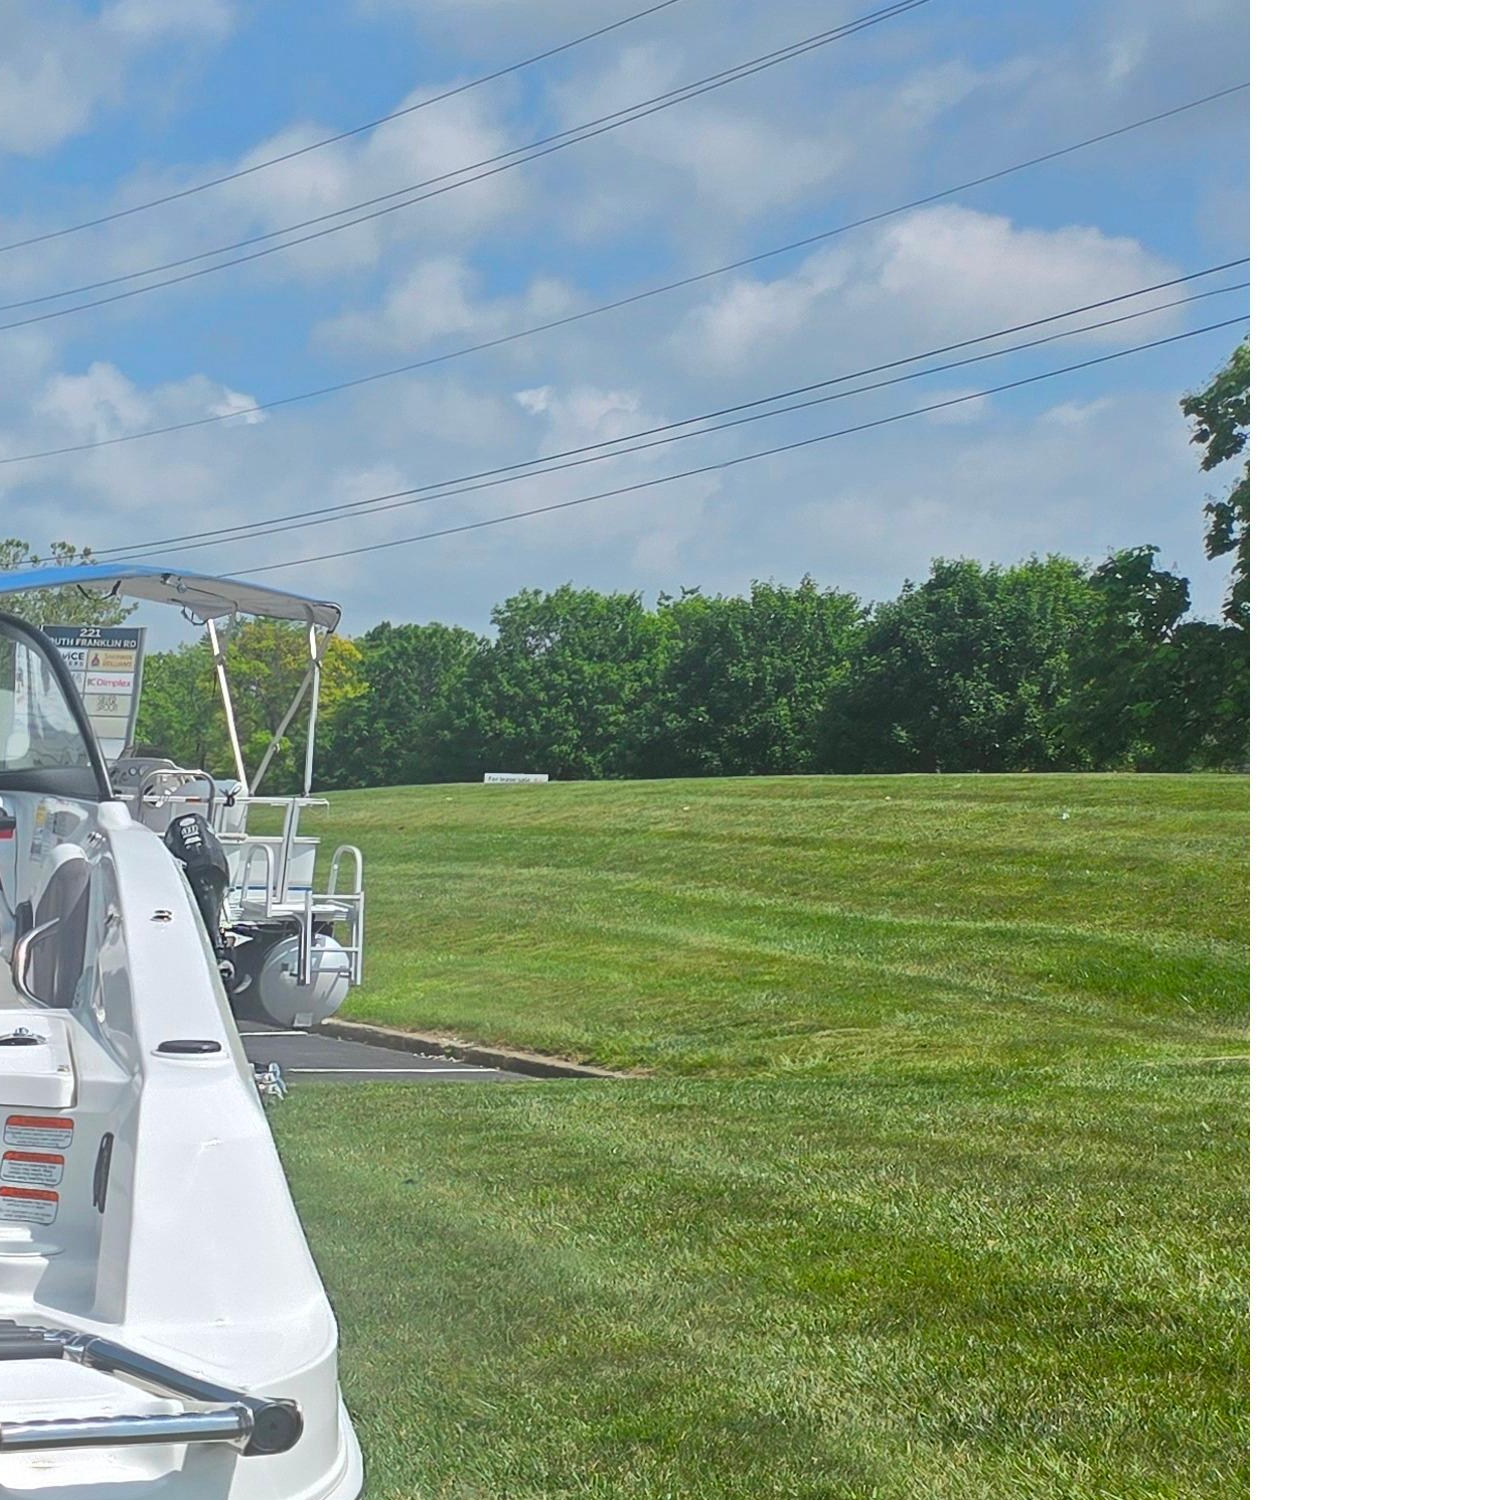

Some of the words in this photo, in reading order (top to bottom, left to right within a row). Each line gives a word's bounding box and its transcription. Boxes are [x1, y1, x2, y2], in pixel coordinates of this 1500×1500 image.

[80, 628, 101, 638] 221
[75, 638, 122, 648] FRANKLIN
[123, 640, 137, 648] RD
